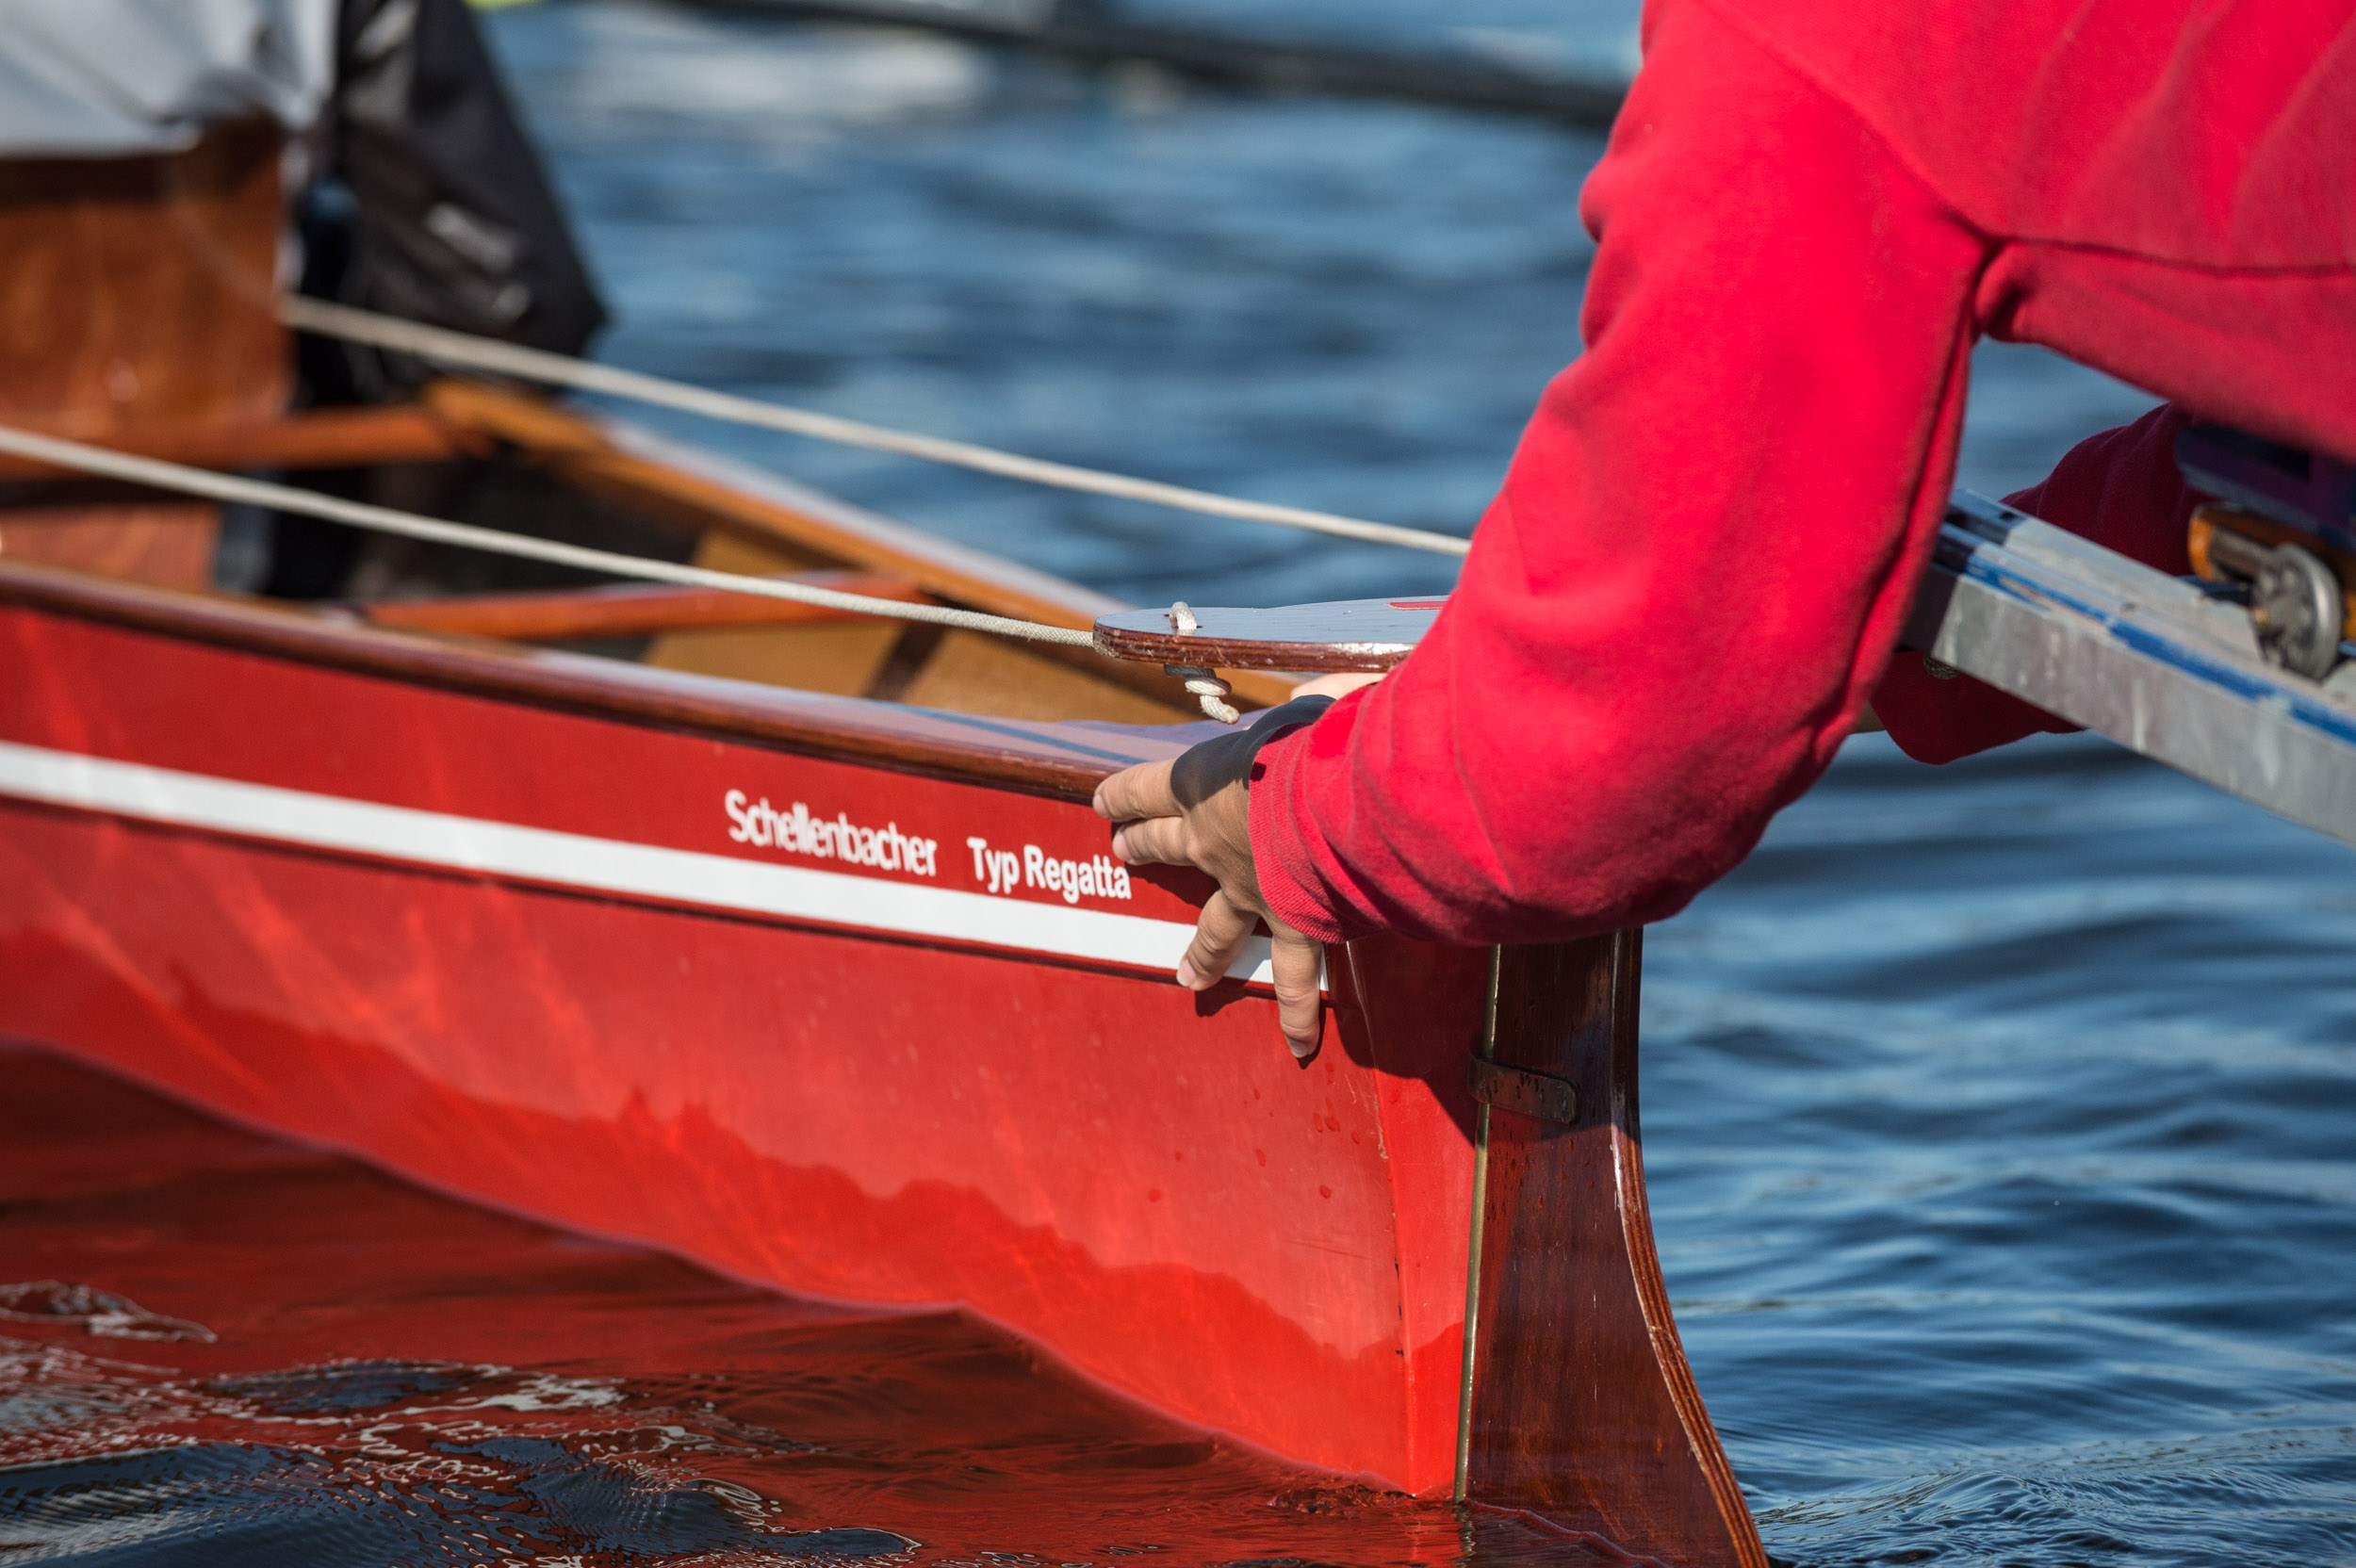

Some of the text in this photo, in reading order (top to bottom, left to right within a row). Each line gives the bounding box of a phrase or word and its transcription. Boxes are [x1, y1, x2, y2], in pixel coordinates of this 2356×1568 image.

[725, 789, 1132, 905] Schellenbacher Typ Regatta
